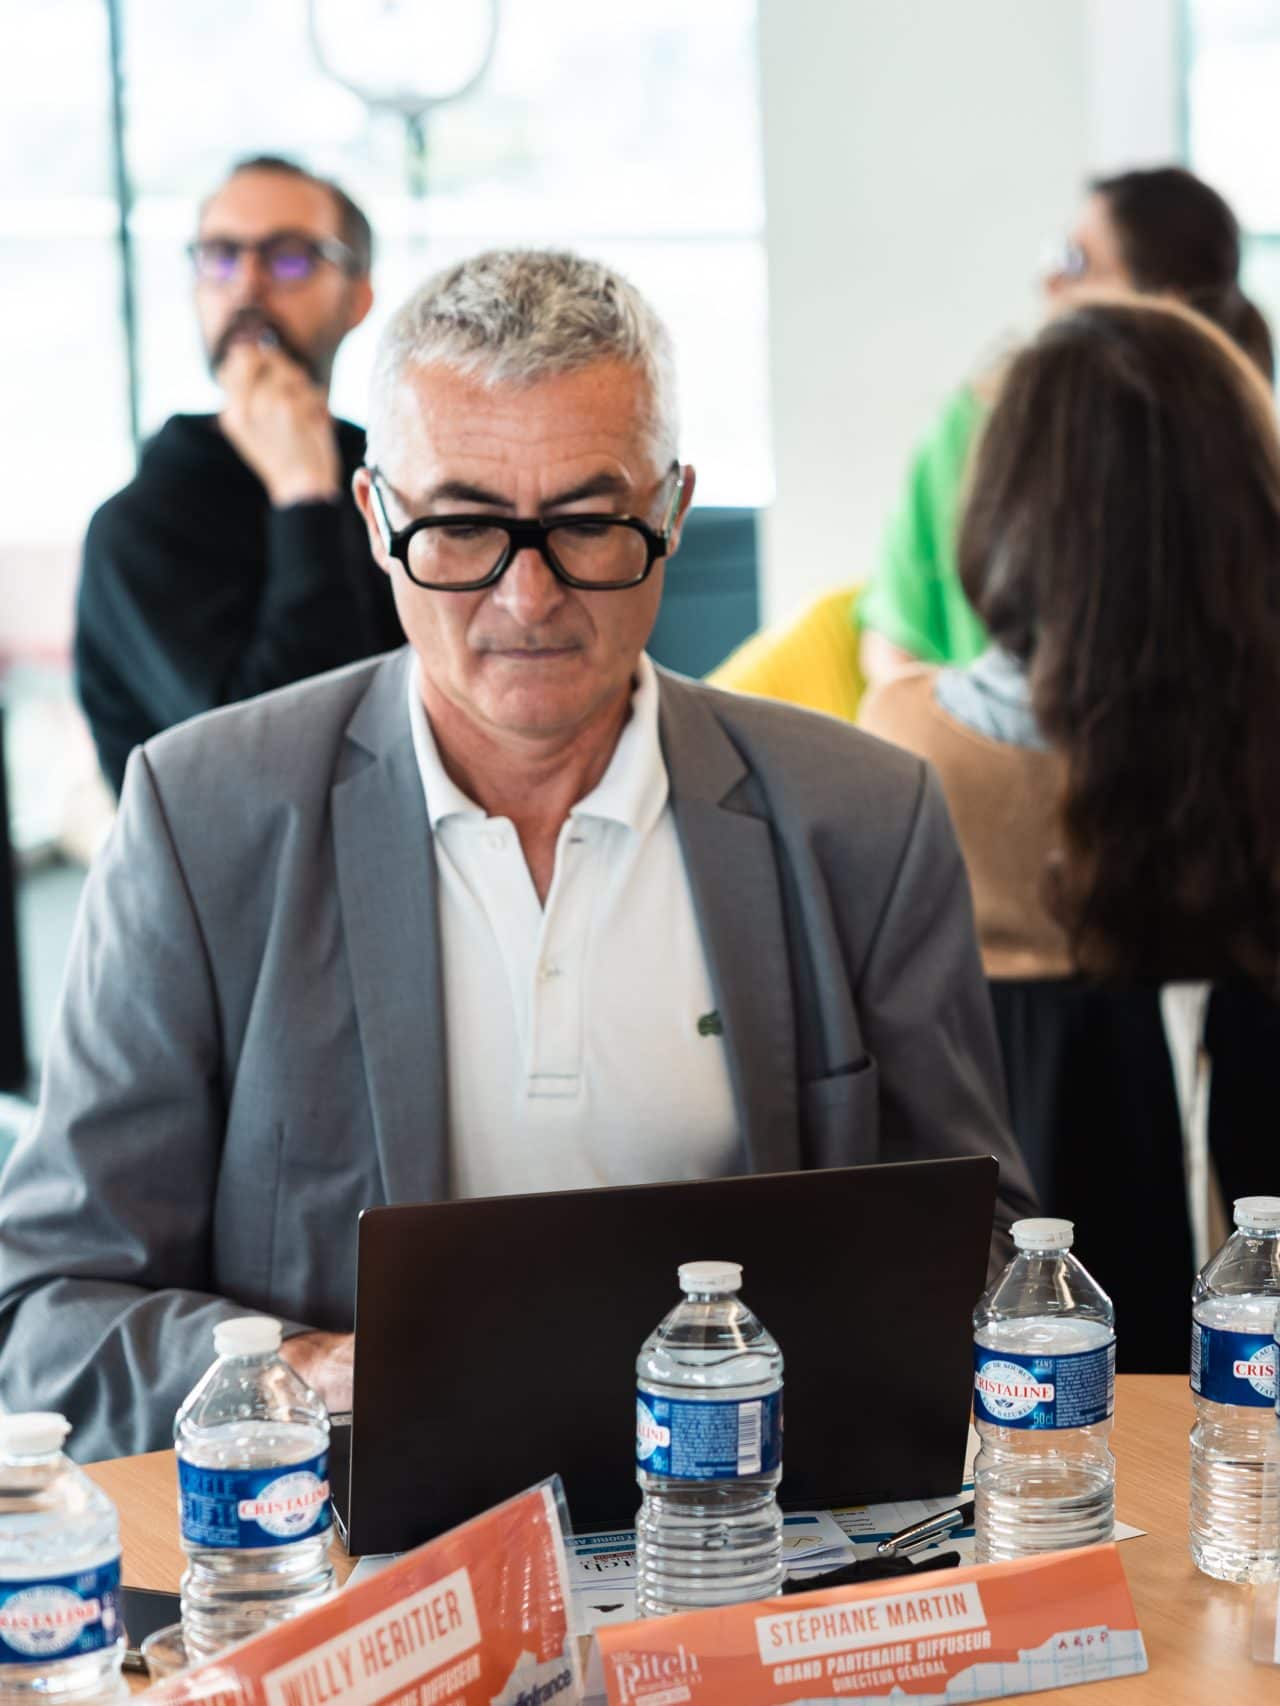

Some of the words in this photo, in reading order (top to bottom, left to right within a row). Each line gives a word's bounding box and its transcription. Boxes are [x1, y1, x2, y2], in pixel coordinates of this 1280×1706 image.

[1033, 1410, 1054, 1425] 50cl
[0, 1602, 95, 1629] RISTALINE
[885, 1592, 969, 1628] MARTIN
[279, 1646, 354, 1706] WILLY
[358, 1589, 463, 1678] HERITIER
[773, 1660, 823, 1686] GRAND
[827, 1643, 913, 1676] PARTENAIRE
[917, 1630, 992, 1659] DIFFUSEUR
[833, 1668, 895, 1693] DIRECTEUR
